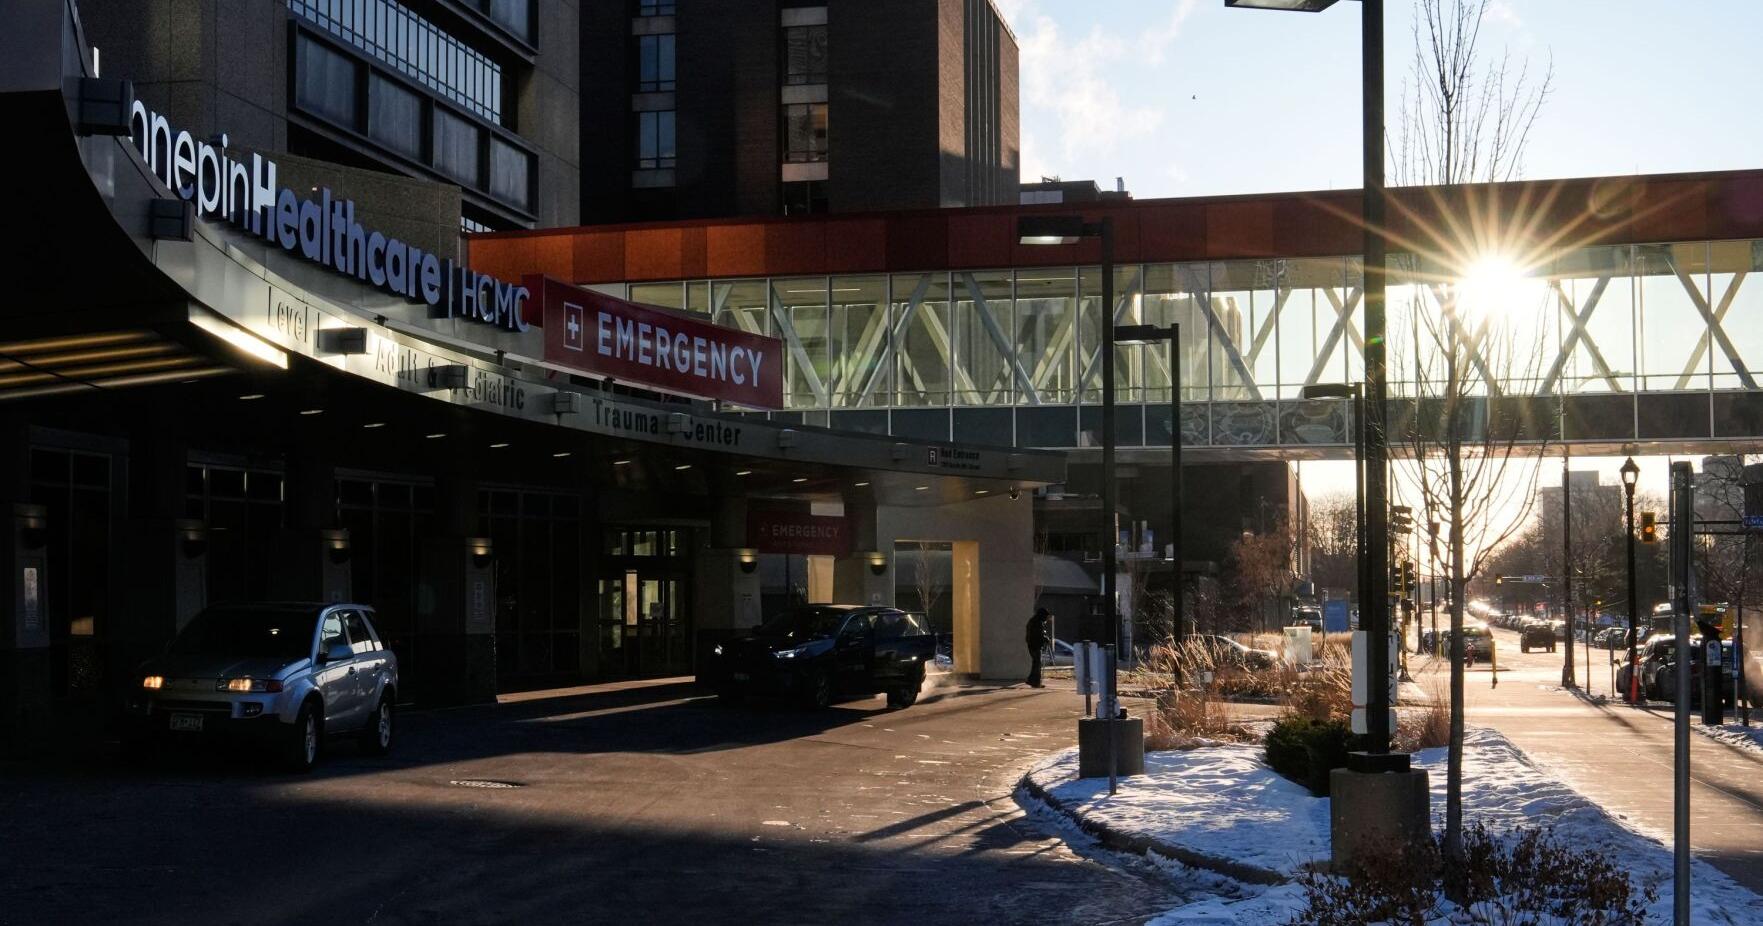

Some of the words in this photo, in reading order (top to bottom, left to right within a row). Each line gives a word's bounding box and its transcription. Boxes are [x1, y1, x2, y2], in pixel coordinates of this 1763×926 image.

[94, 46, 440, 304] nnepinHealthcare
[461, 267, 530, 333] HCMC
[267, 285, 308, 343] Level
[376, 338, 418, 384] Adult
[427, 357, 438, 389] &
[452, 371, 525, 410] diatric
[593, 399, 658, 434] Trauma
[597, 311, 763, 388] EMERGENCY
[771, 523, 839, 538] EMERGENCY
